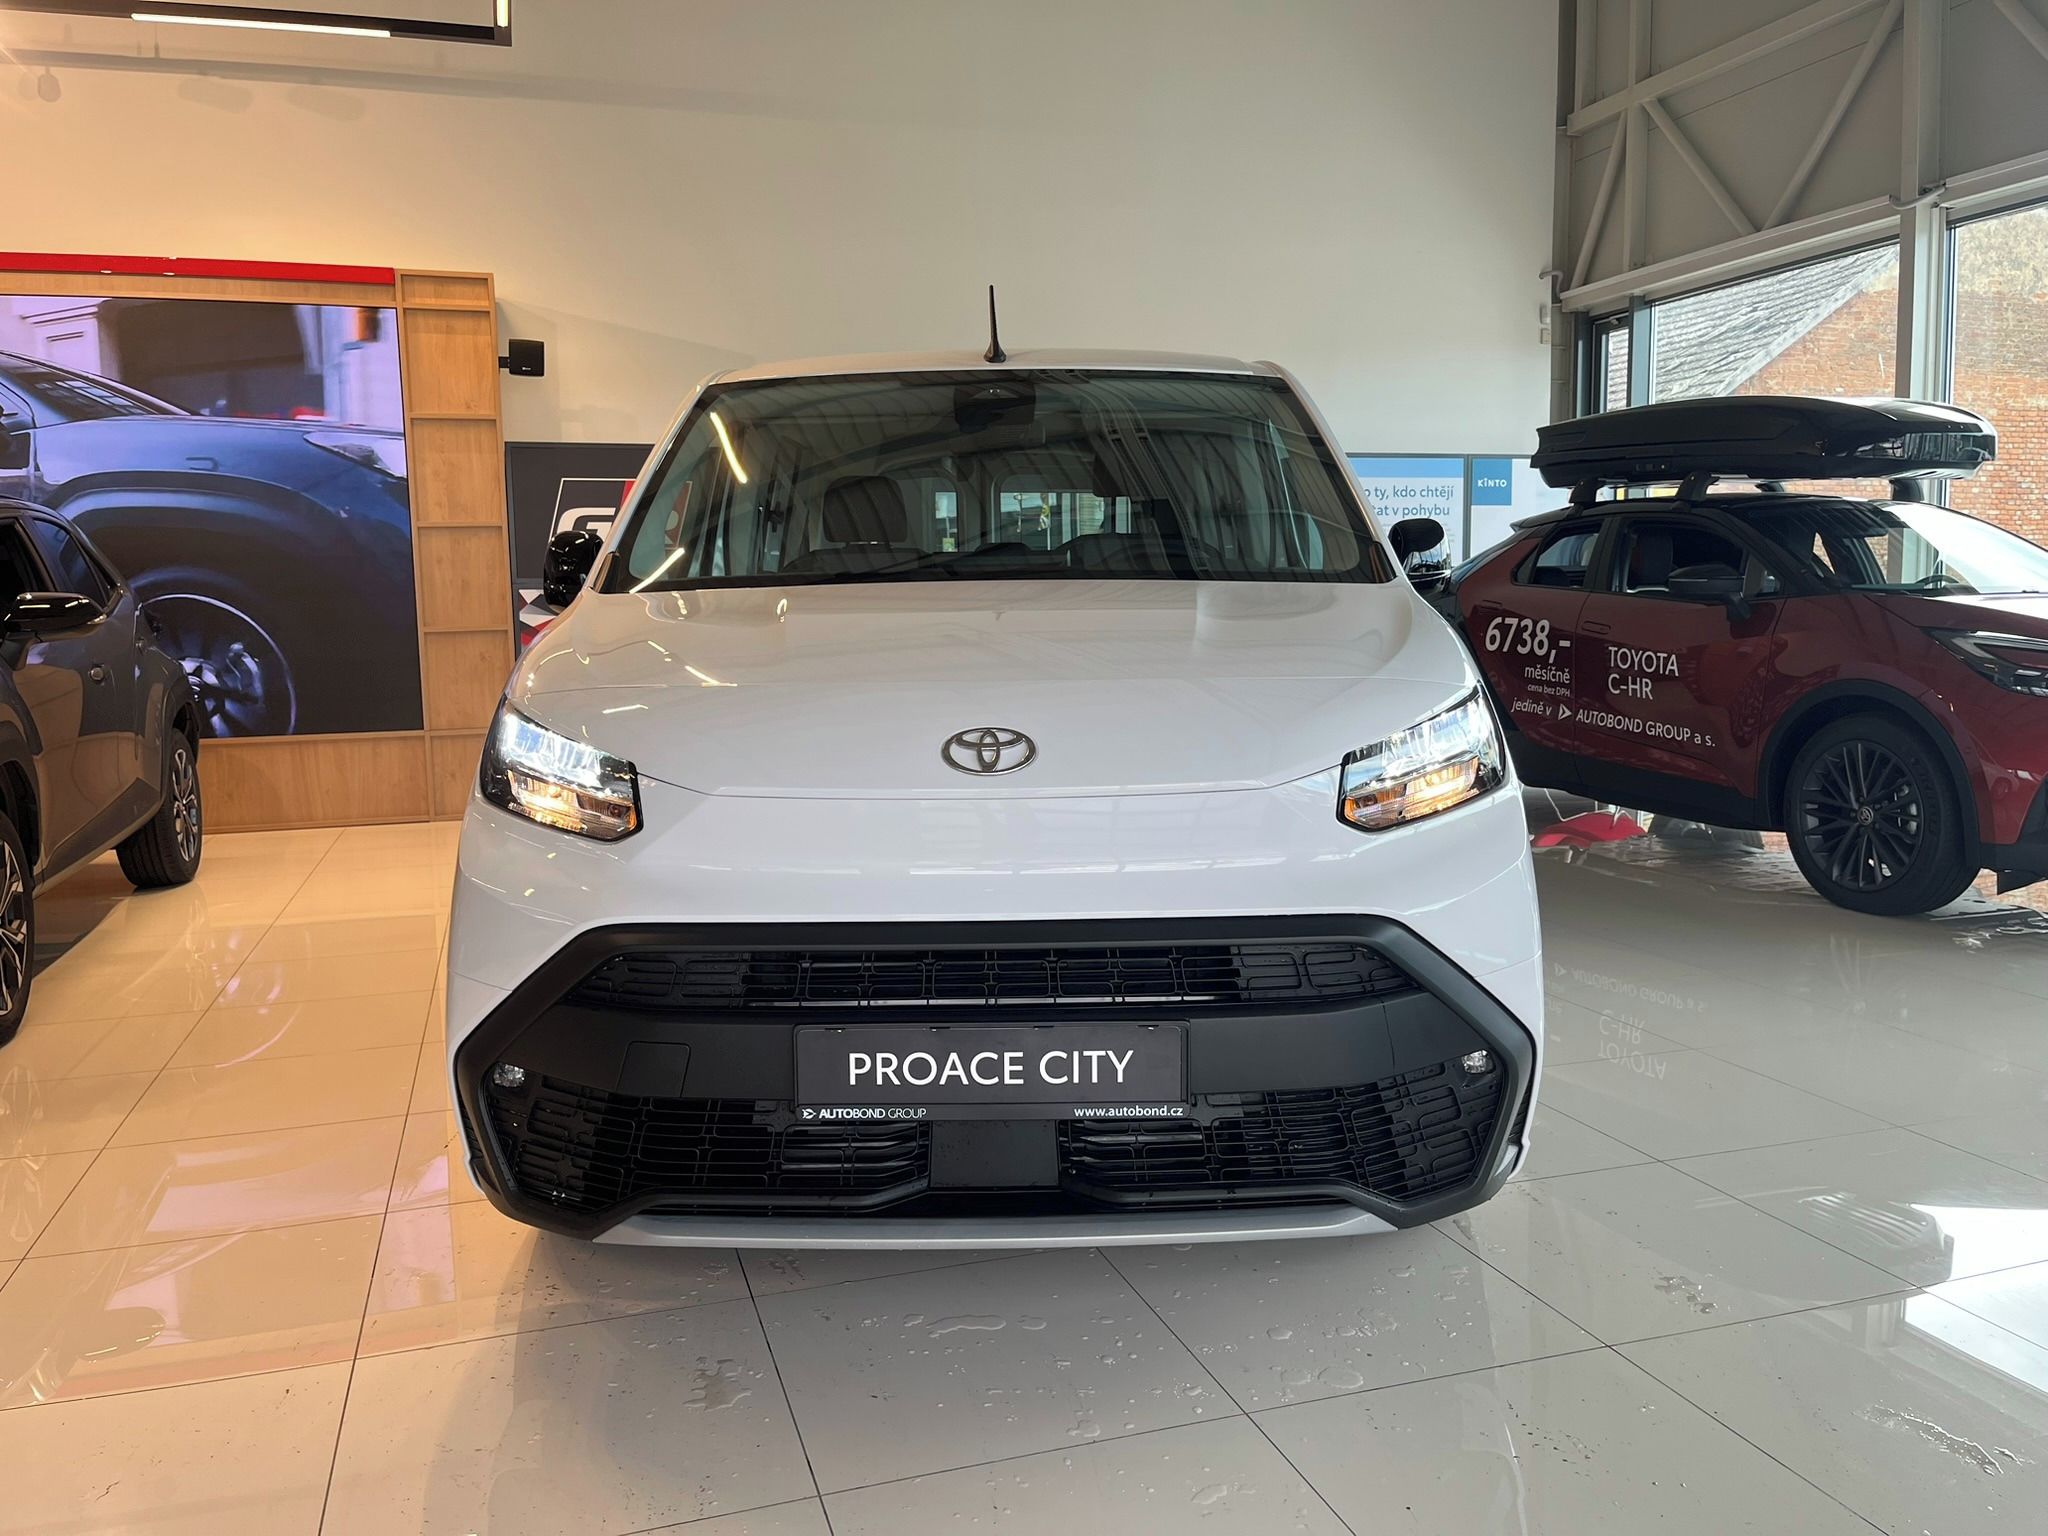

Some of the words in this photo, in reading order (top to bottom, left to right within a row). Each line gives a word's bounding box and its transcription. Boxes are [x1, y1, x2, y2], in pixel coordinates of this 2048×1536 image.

[1374, 486, 1390, 501] ty,
[1393, 484, 1417, 498] kdo
[1420, 484, 1455, 501] chtějí
[1392, 507, 1400, 516] v
[1402, 503, 1450, 519] pohybu
[1485, 616, 1571, 664] 6738,-
[1608, 646, 1679, 677] TOYOTA
[1524, 663, 1571, 684] měsíčně
[1527, 683, 1543, 693] cena
[1543, 684, 1555, 695] bez
[1556, 687, 1571, 697] DPH
[1608, 673, 1653, 700] C-HR
[1510, 697, 1544, 715] jedině
[1545, 705, 1553, 716] v
[1576, 709, 1643, 733] AUTOBOND
[1645, 721, 1691, 742] GROUP
[1694, 733, 1702, 745] a
[1705, 735, 1716, 747] s.
[849, 1051, 1024, 1086] PROACE
[1039, 1050, 1134, 1085] CITY
[819, 1107, 886, 1119] AUTOBOND
[887, 1107, 927, 1119] GROUP
[1073, 1104, 1184, 1117] www.autobond.cz
